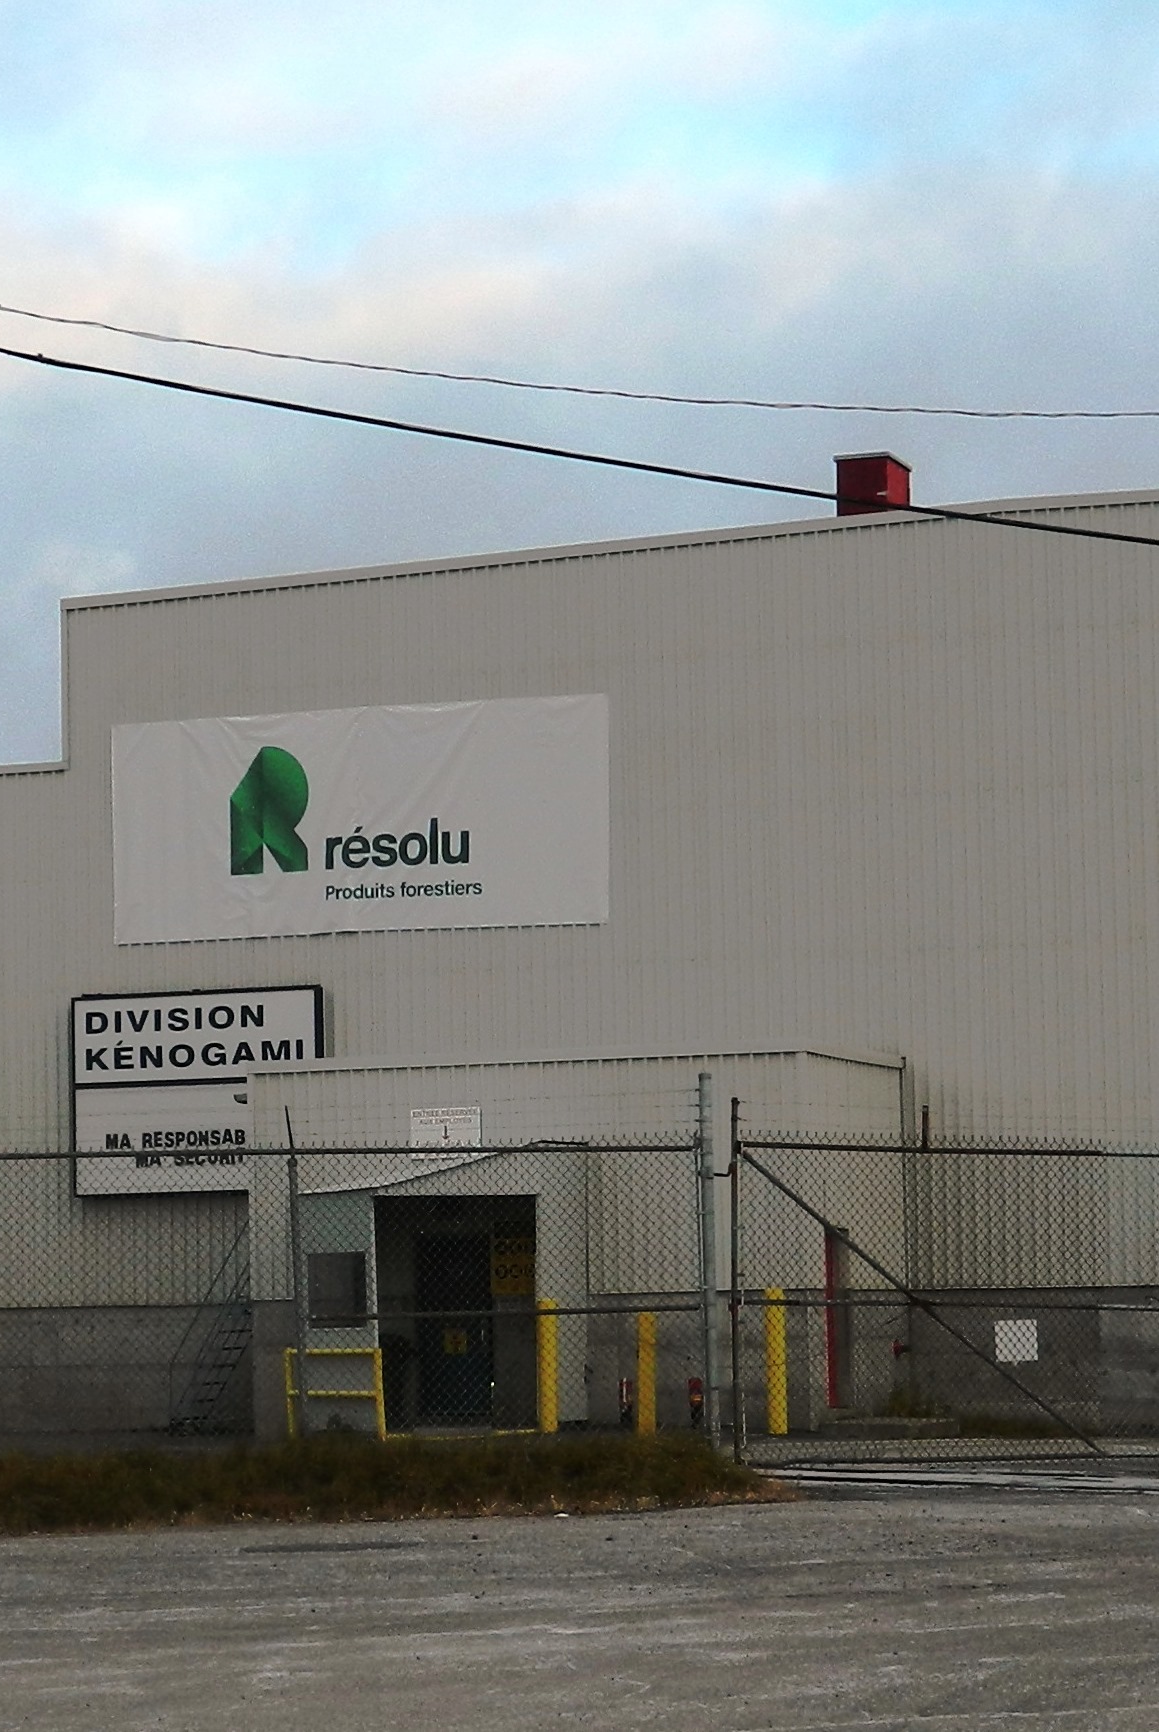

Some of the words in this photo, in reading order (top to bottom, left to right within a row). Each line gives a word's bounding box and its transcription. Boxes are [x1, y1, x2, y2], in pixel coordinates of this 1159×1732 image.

[324, 817, 470, 870] résolu
[325, 882, 395, 901] Produits
[400, 879, 483, 898] forestiers
[85, 1004, 264, 1035] DIVISION
[85, 1039, 304, 1071] KÉNOGAMI
[105, 1133, 132, 1150] MA
[141, 1129, 246, 1149] RESPONSAB
